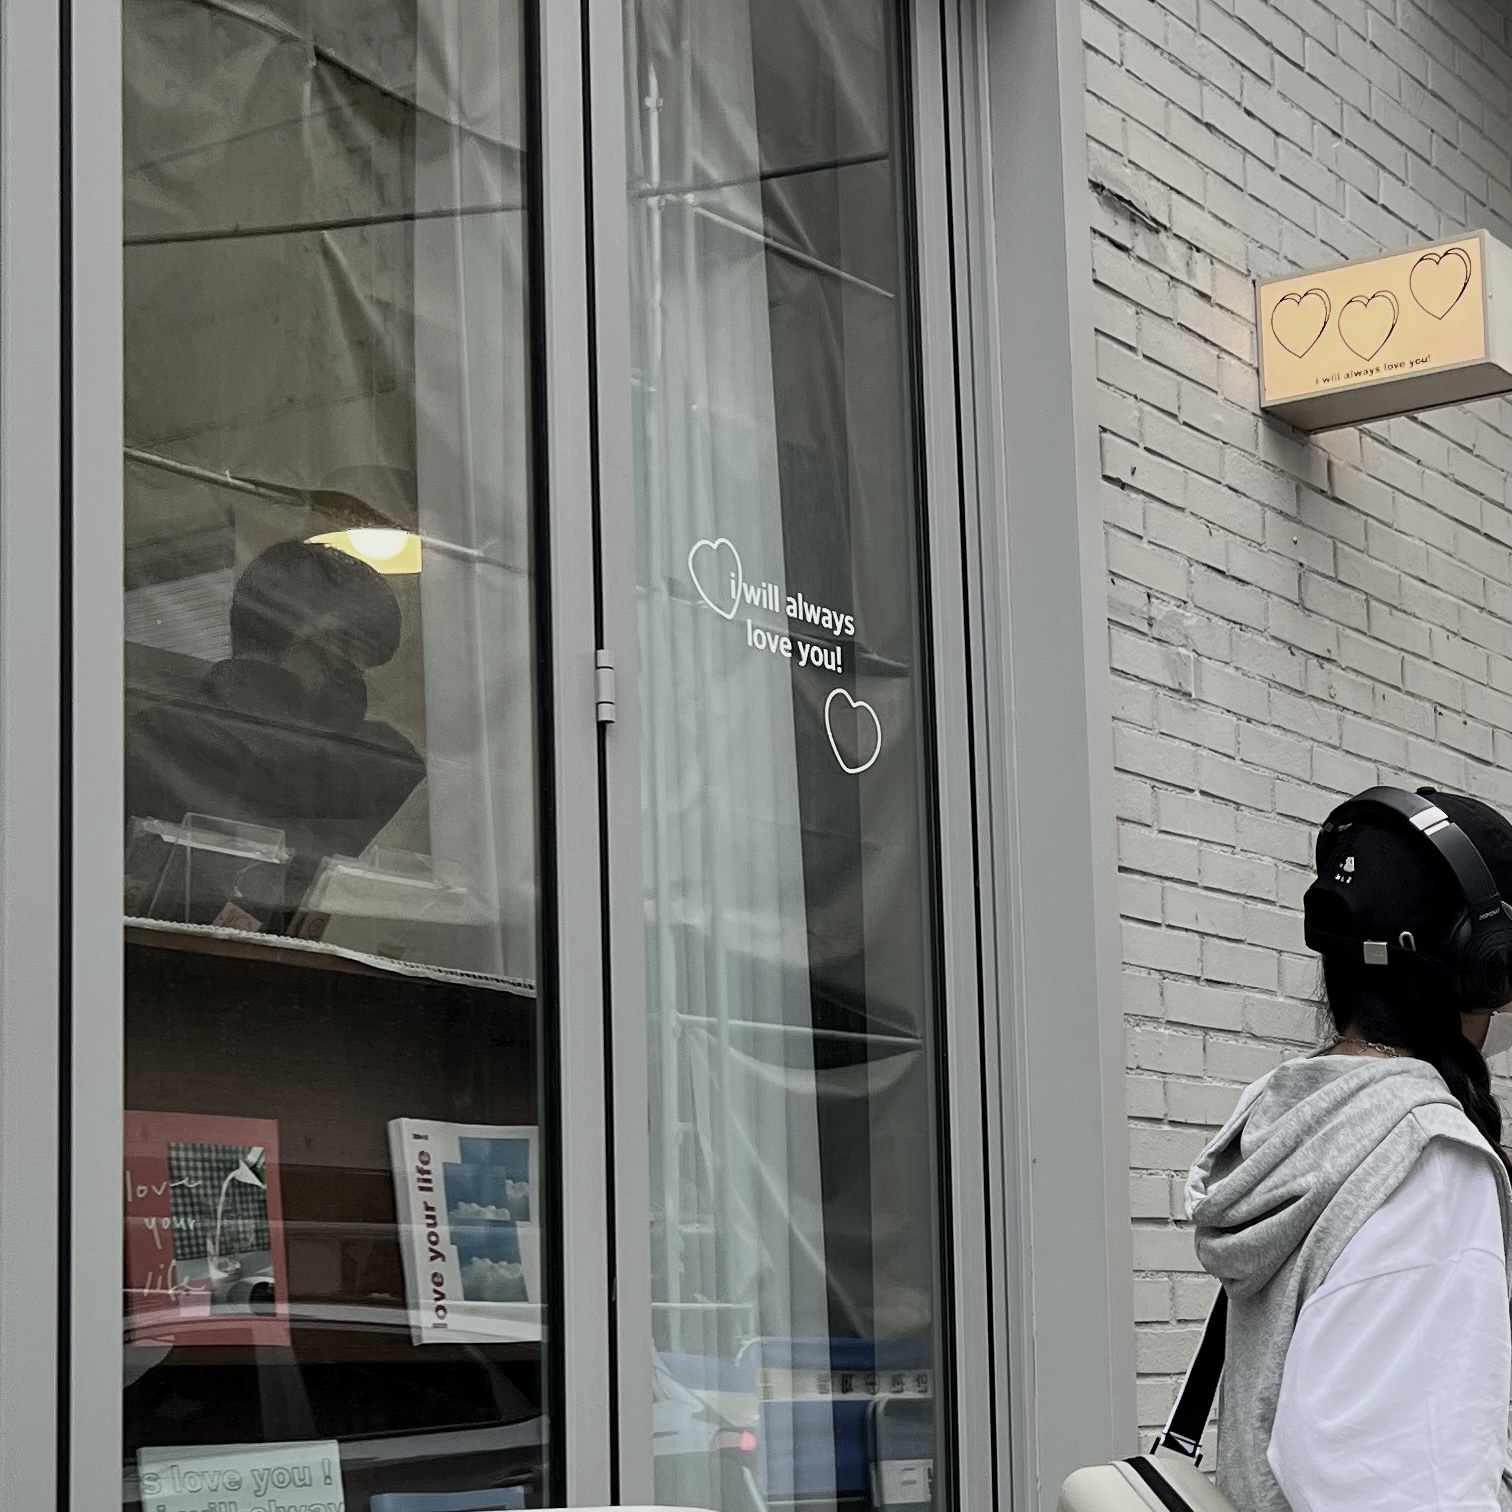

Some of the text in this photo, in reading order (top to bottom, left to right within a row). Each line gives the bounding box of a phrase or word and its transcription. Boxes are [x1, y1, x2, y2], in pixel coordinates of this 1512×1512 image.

[1322, 373, 1340, 383] will
[1344, 367, 1380, 378] always
[1384, 361, 1406, 371] love
[1409, 354, 1431, 367] you!
[730, 571, 855, 636] i will always
[746, 618, 843, 674] love you!
[415, 1150, 434, 1193] life
[143, 1217, 196, 1250] your
[423, 1200, 446, 1263] your
[431, 1271, 448, 1329] love
[169, 1464, 243, 1493] love
[251, 1465, 312, 1497] you
